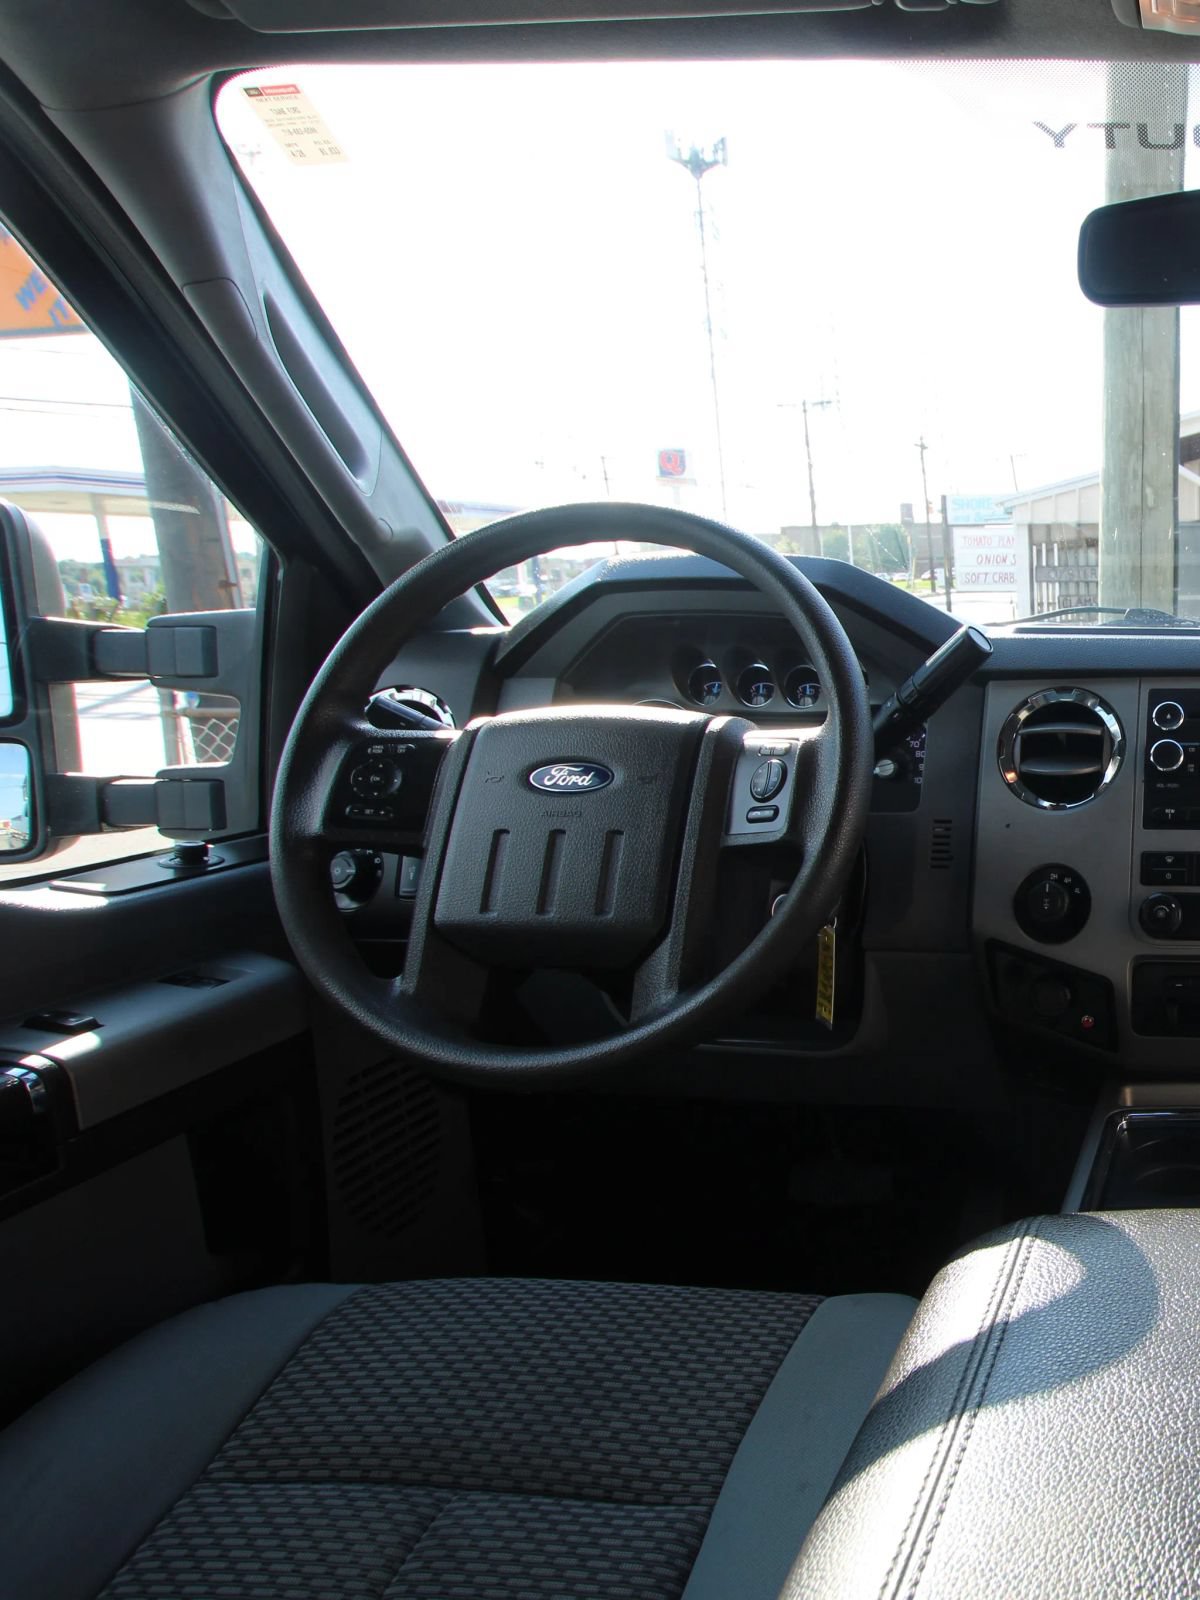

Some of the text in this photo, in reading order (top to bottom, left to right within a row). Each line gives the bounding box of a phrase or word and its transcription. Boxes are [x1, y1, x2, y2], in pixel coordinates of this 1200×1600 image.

[963, 535, 992, 546] TOMATO
[964, 571, 1017, 584] SOFT CRAB
[909, 740, 920, 748] 70
[543, 766, 594, 787] Ford
